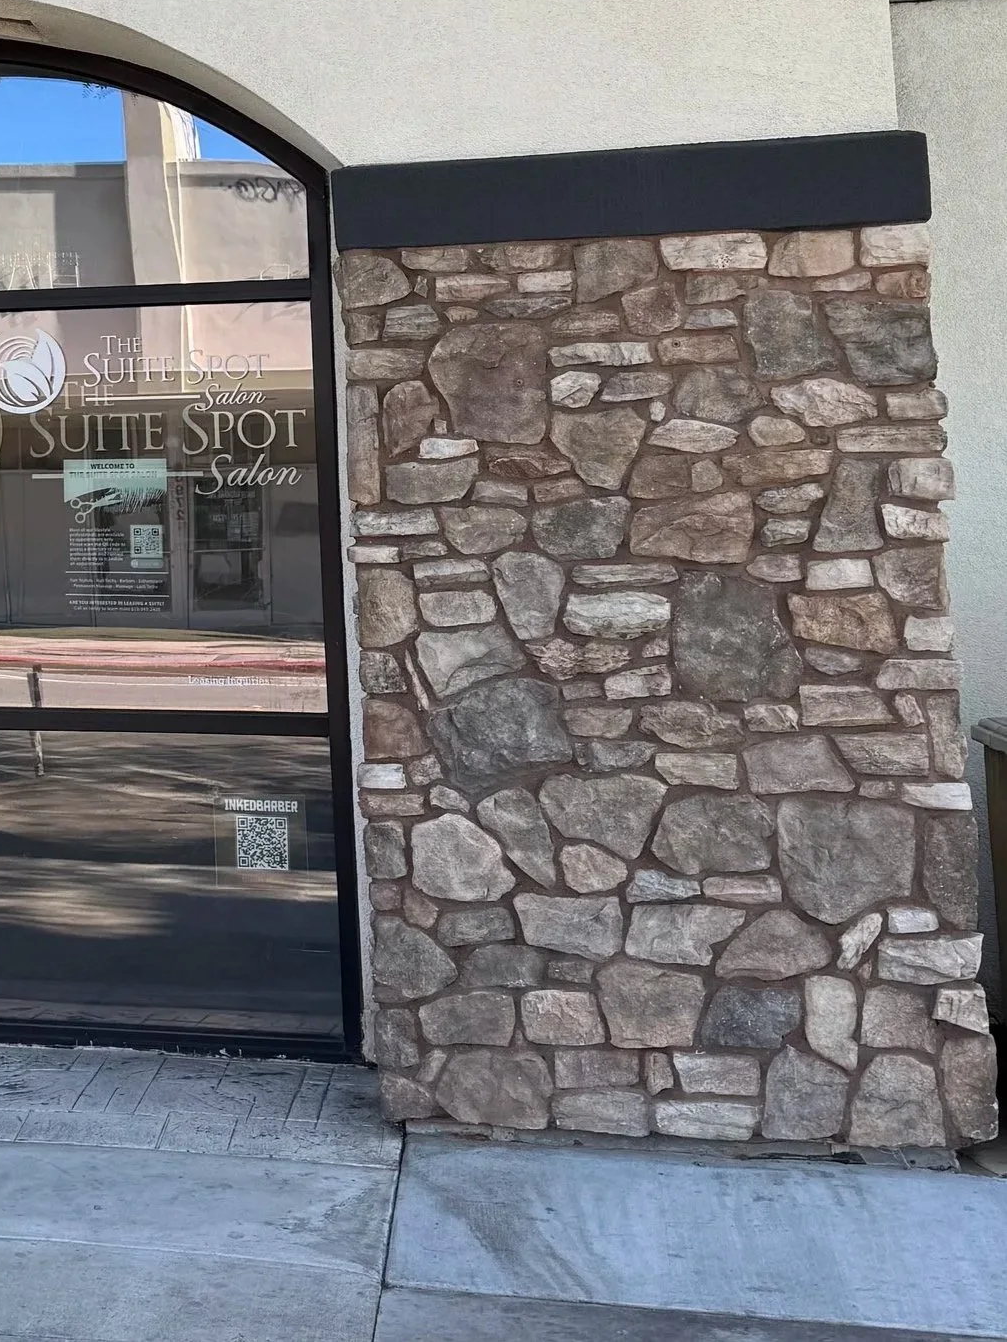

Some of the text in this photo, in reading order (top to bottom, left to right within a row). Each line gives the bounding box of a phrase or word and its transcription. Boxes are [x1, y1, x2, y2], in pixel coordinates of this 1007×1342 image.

[100, 335, 143, 353] THE
[83, 349, 270, 387] SUITE SPOT
[196, 382, 266, 412] Salon
[30, 404, 306, 458] SUITE SPOT
[195, 454, 301, 495] Salon
[188, 675, 224, 686] Leasing
[224, 799, 298, 813] INKEDBARBER
